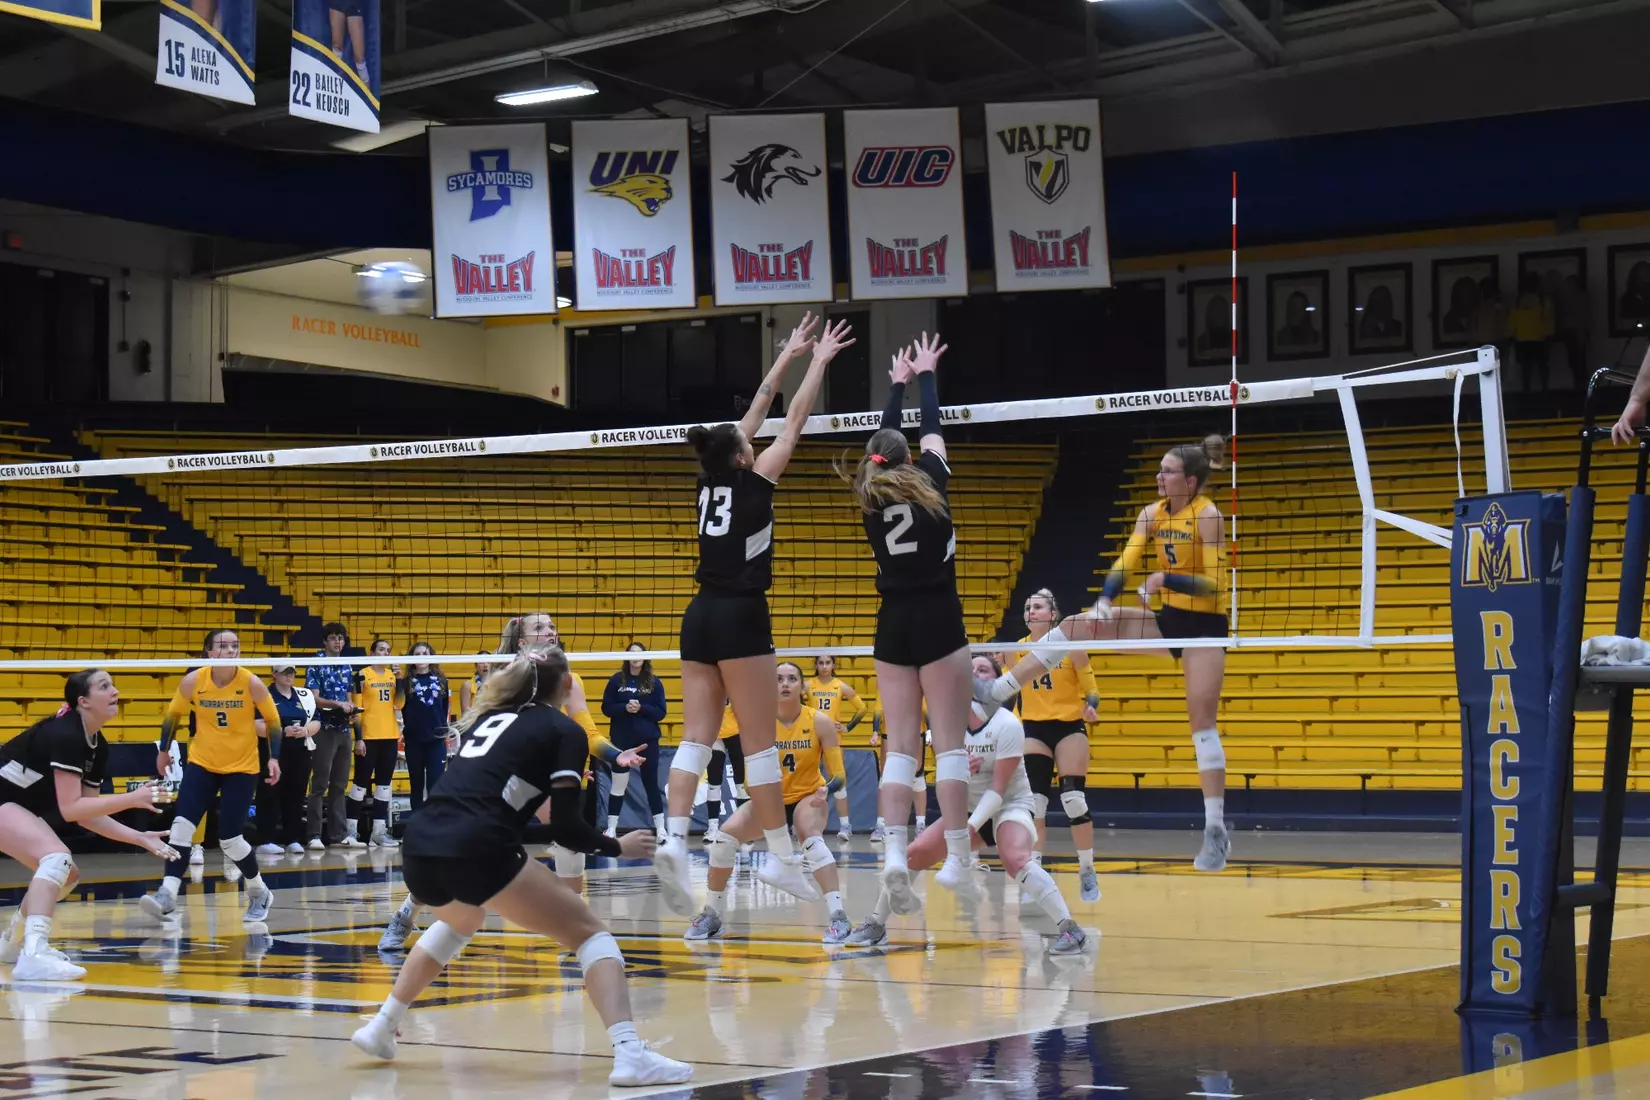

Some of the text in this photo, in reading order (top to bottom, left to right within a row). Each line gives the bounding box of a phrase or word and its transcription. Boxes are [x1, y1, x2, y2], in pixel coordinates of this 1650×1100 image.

[164, 38, 186, 78] 15
[190, 46, 217, 68] ALEXA
[190, 64, 220, 86] WATTS
[315, 73, 344, 96] BAILEY
[291, 69, 312, 108] 22
[316, 92, 350, 117] KEUSCH
[996, 124, 1091, 155] VALPO
[589, 150, 680, 187] UNI
[855, 148, 952, 186] UIC
[448, 171, 533, 189] SYCAMORES
[893, 238, 919, 248] THE
[1036, 230, 1062, 240] THE
[479, 254, 506, 264] THE
[620, 248, 646, 258] THE
[759, 243, 784, 253] THE
[865, 234, 949, 278] VALLEY
[1009, 225, 1091, 271] VALLEY
[450, 250, 536, 295] VALLEY
[592, 245, 677, 289] VALLEY
[730, 239, 814, 284] VALLEY
[292, 314, 422, 348] RACER VOLLEYBALL
[1109, 394, 1151, 409] RACER
[843, 415, 881, 427] RACER
[601, 428, 687, 443] RACER VOLLEYB
[380, 441, 477, 457] RACER VOLLEYBALL
[0, 464, 72, 477] CER VOLLEYBALL
[177, 454, 267, 468] RACER VOLLEYBALL
[699, 485, 733, 537] 13
[883, 503, 918, 556] 2
[1163, 543, 1178, 565] 5
[1032, 673, 1053, 690] 14
[225, 699, 245, 709] STATE
[379, 689, 390, 702] 15
[819, 698, 831, 710] 12
[216, 711, 228, 727] 2
[459, 712, 519, 759] 9
[775, 739, 812, 749] RRAY STATE
[782, 753, 796, 772] 4
[1479, 610, 1523, 995] RACERS
